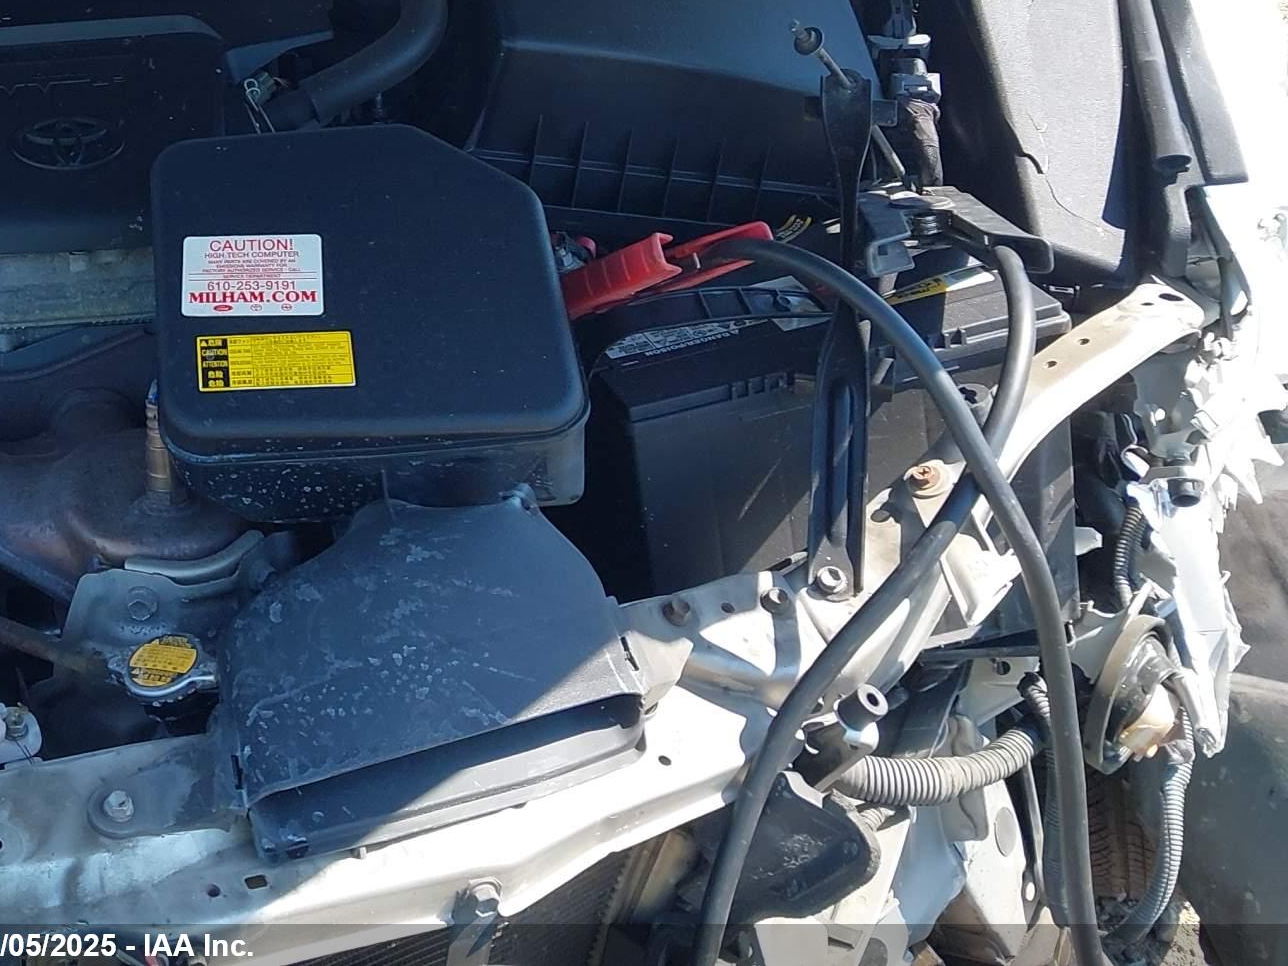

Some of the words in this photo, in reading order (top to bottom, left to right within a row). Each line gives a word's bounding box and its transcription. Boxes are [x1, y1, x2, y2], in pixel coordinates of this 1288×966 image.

[209, 238, 294, 251] CAUTION!
[251, 250, 300, 258] COMPUTER
[207, 280, 296, 291] 610-253-9191
[189, 291, 317, 303] MILHAM.COM
